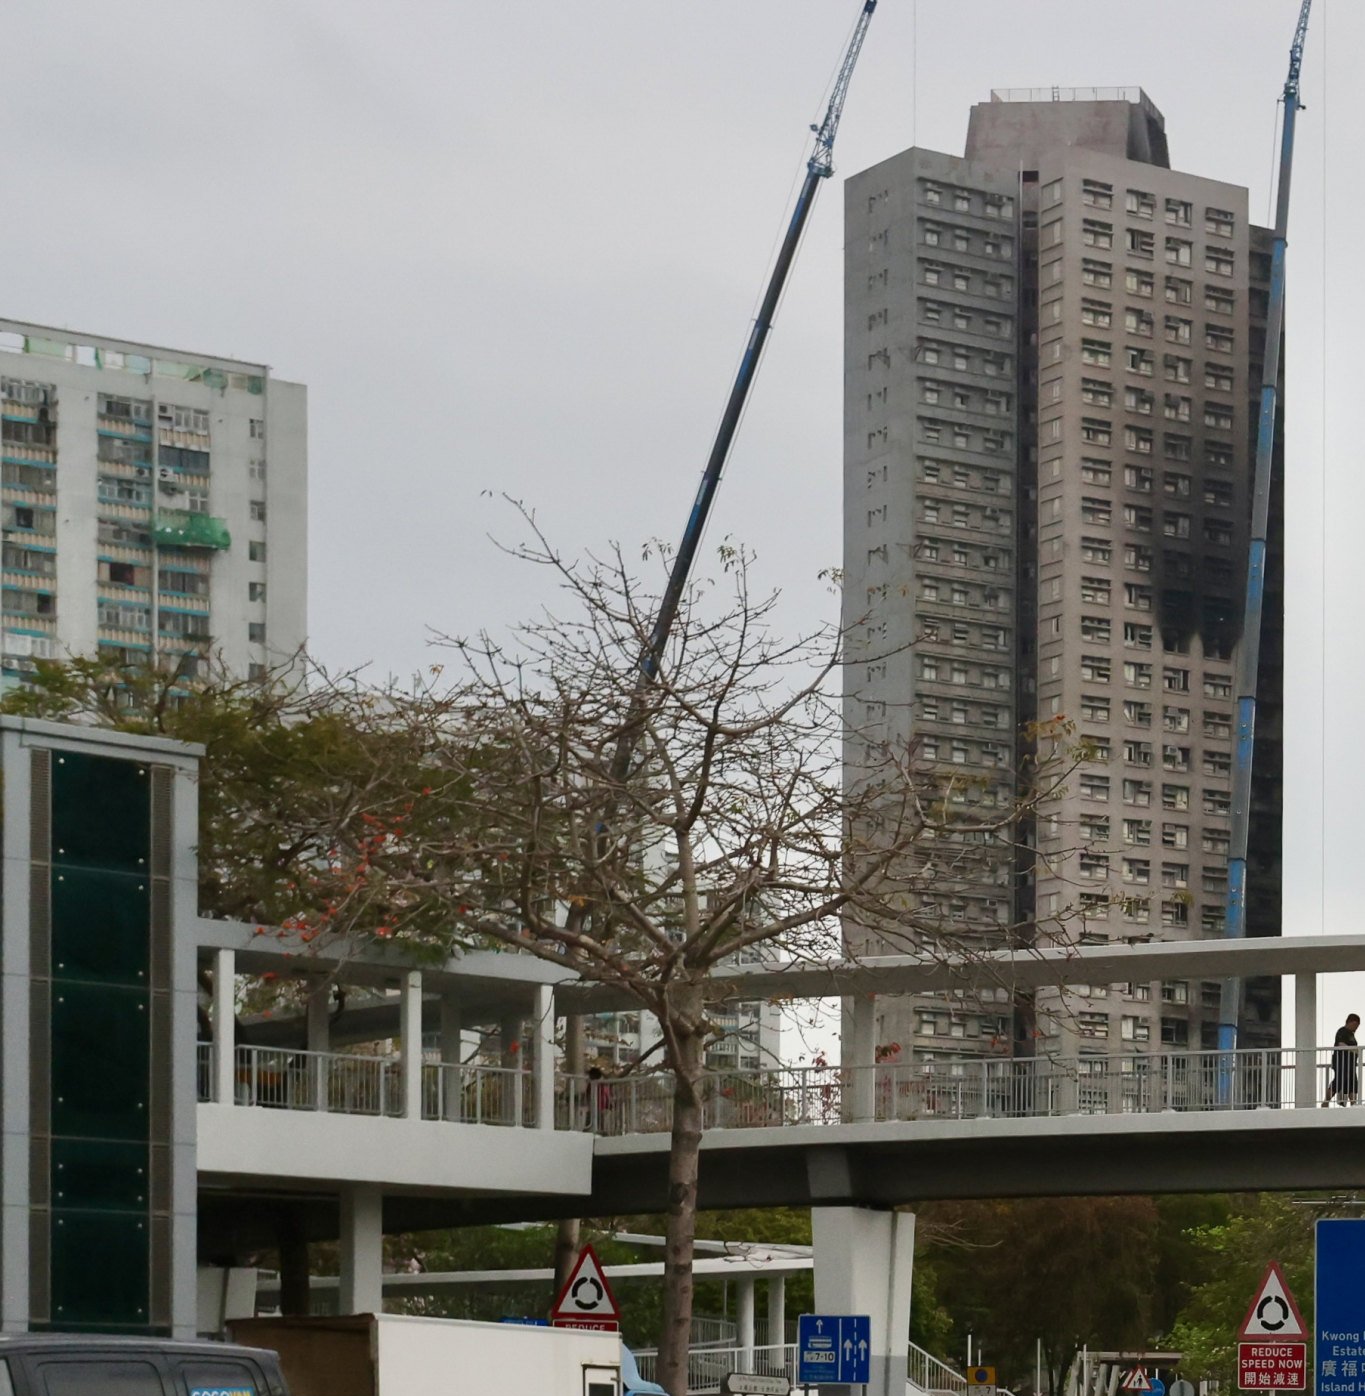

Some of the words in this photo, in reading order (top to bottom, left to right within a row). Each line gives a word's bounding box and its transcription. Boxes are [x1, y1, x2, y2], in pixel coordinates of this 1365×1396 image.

[1322, 1330, 1360, 1343] Kwong
[1251, 1347, 1293, 1357] REDUCE
[1241, 1359, 1275, 1369] SPEED
[1278, 1359, 1303, 1369] NOW
[1244, 1371, 1299, 1385] 開始減速
[1321, 1382, 1355, 1392] Island
